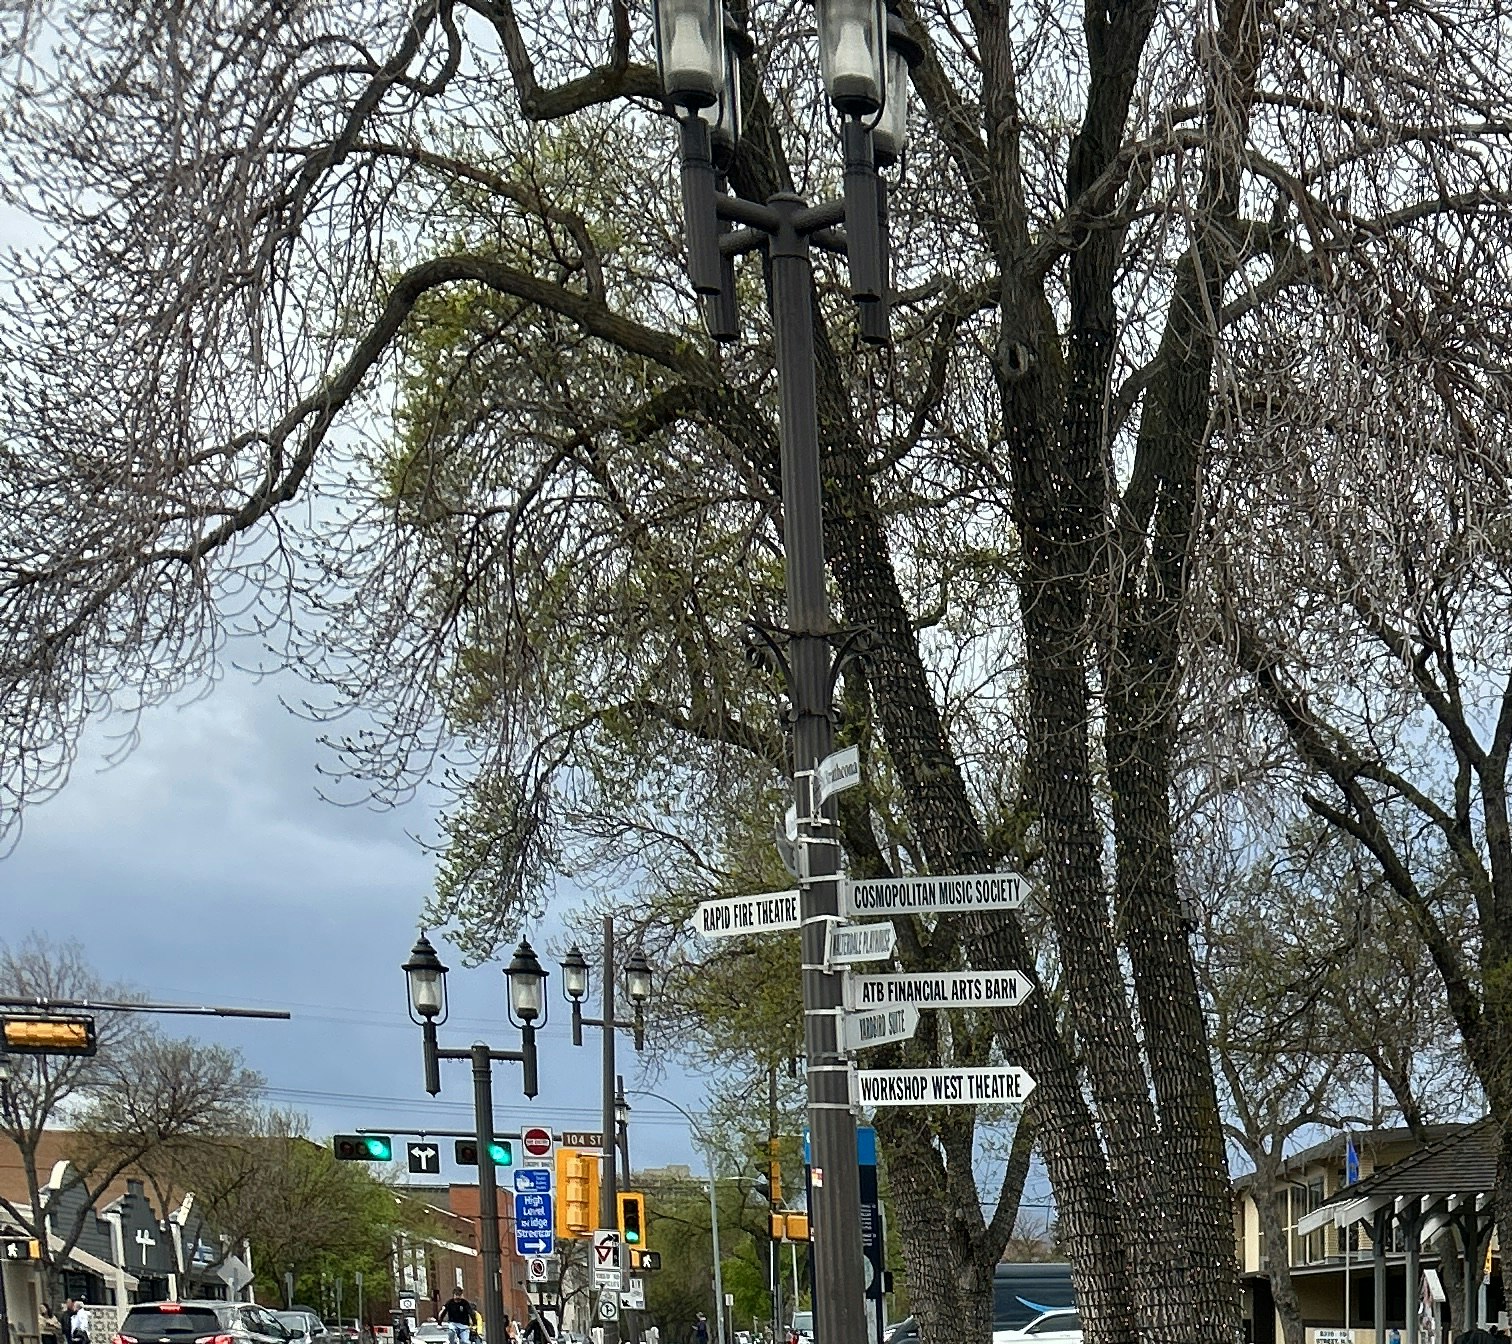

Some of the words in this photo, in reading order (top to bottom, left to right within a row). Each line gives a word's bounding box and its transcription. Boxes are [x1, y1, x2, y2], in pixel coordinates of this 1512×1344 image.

[855, 883, 936, 909] COSMOPOLITAN
[939, 880, 973, 905] MUSIC
[976, 878, 1021, 903] SOCIETY
[703, 906, 730, 932] RAPID
[734, 902, 754, 927] FIRE
[756, 897, 797, 925] THEATRE
[863, 981, 885, 1003] ATB
[888, 979, 949, 1001] FINANCIAL
[952, 978, 982, 1000] ARTS
[985, 977, 1017, 1000] BARN
[860, 1075, 928, 1102] WORKSHOP
[931, 1075, 964, 1099] WEST
[967, 1073, 1022, 1099] THEATRE
[566, 1134, 585, 1146] 104
[589, 1135, 602, 1146] ST
[524, 1195, 544, 1207] High
[523, 1206, 545, 1216] Level
[516, 1229, 552, 1238] Streetcar
